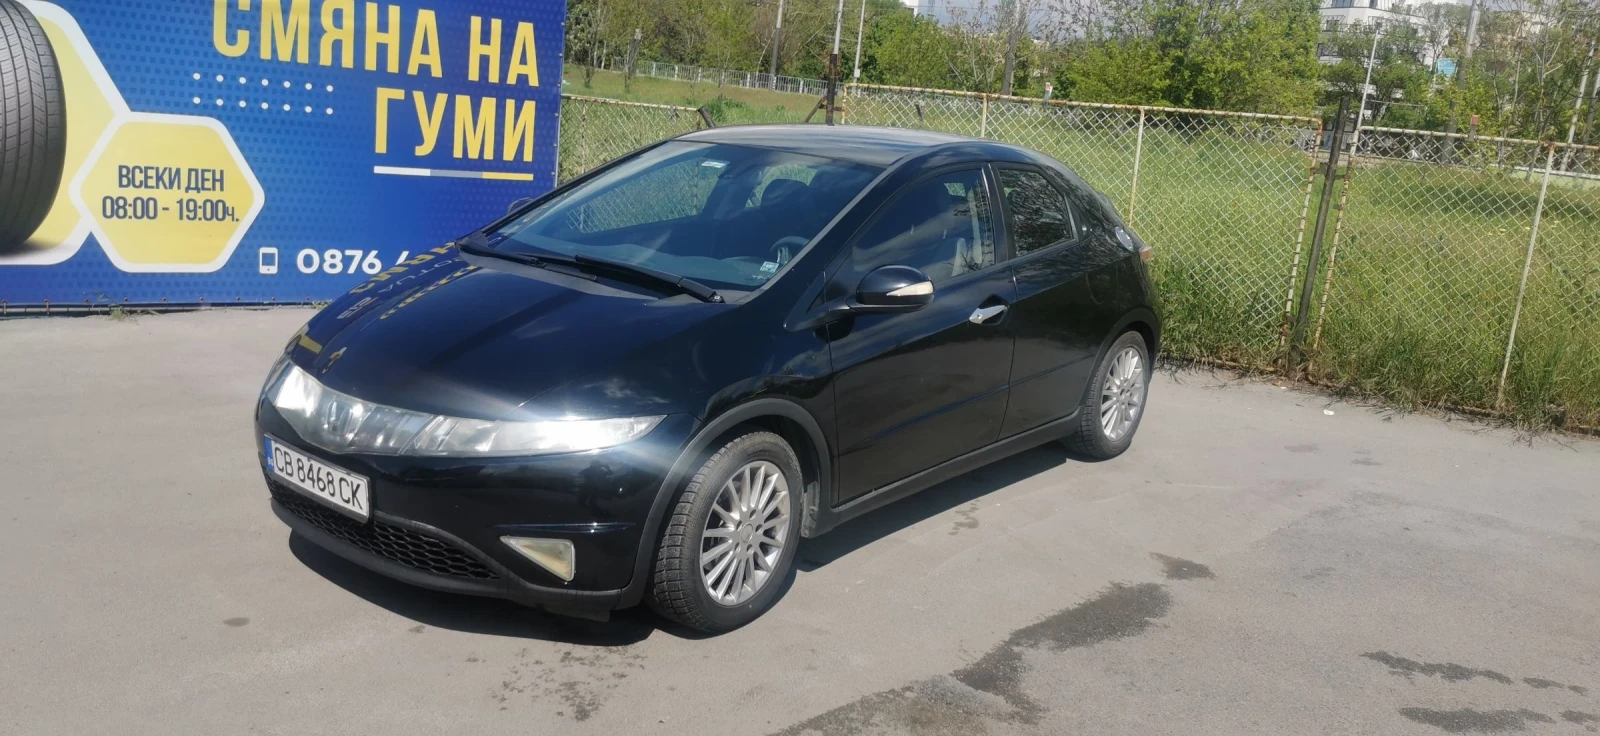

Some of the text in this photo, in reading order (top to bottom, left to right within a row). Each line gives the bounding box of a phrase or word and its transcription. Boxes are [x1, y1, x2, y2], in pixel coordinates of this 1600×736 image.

[213, 0, 540, 87] СМЯНА НА
[375, 87, 536, 162] ГУМИ
[118, 165, 224, 193] ВСЕКИ ДЕН
[102, 195, 158, 219] 08:00
[176, 198, 240, 222] 19:00ч.
[297, 248, 382, 275] 0876
[297, 457, 336, 498] 8468
